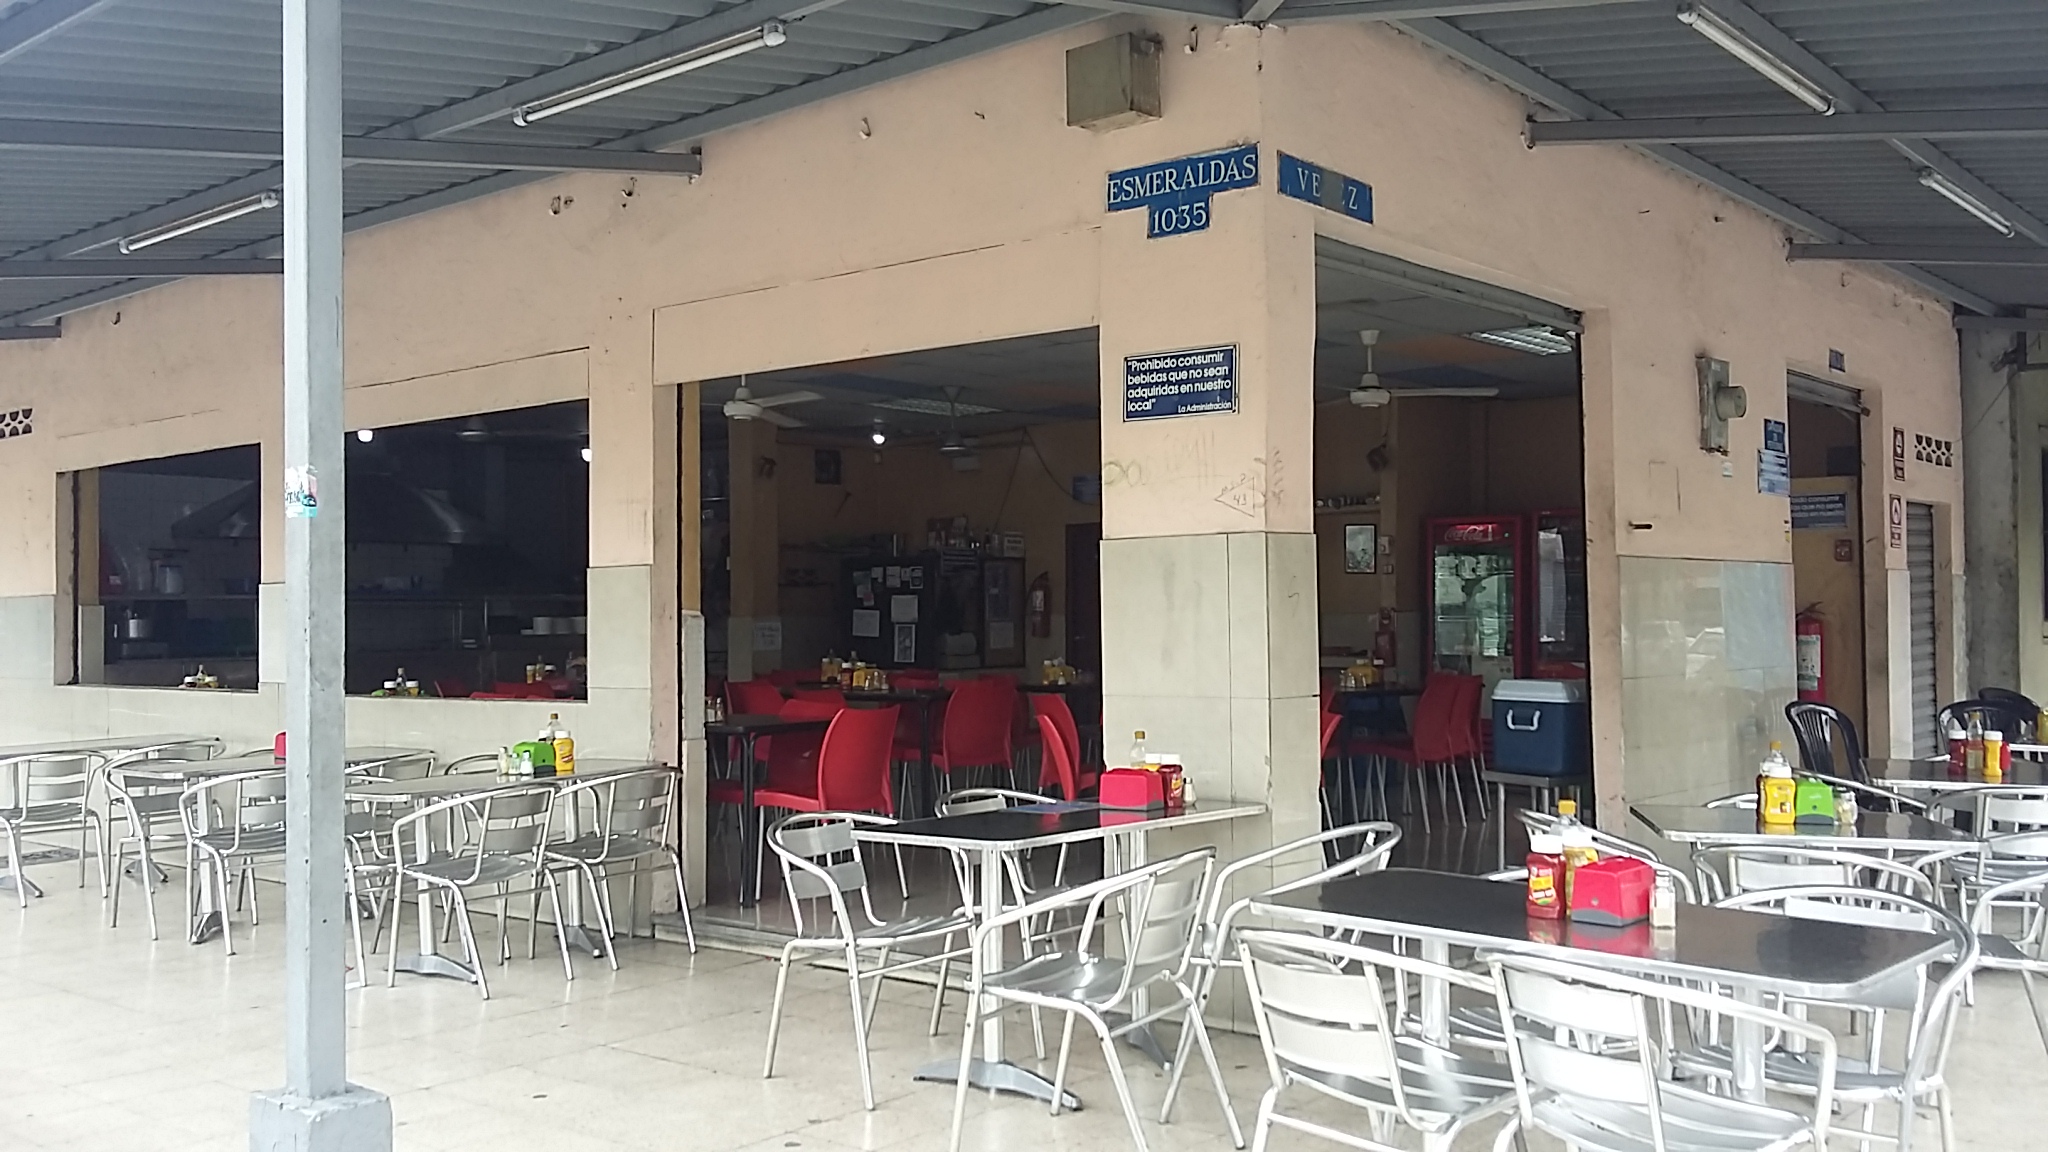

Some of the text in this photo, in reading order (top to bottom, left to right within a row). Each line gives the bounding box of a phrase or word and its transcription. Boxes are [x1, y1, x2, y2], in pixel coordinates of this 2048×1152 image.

[1108, 154, 1257, 203] ESMERALDAS
[1153, 202, 1207, 233] 1035
[1178, 352, 1224, 366] consumir
[1128, 366, 1229, 385] bebidas que no sean
[1128, 379, 1231, 399] adquiridas en nuestro
[1178, 405, 1186, 413] La
